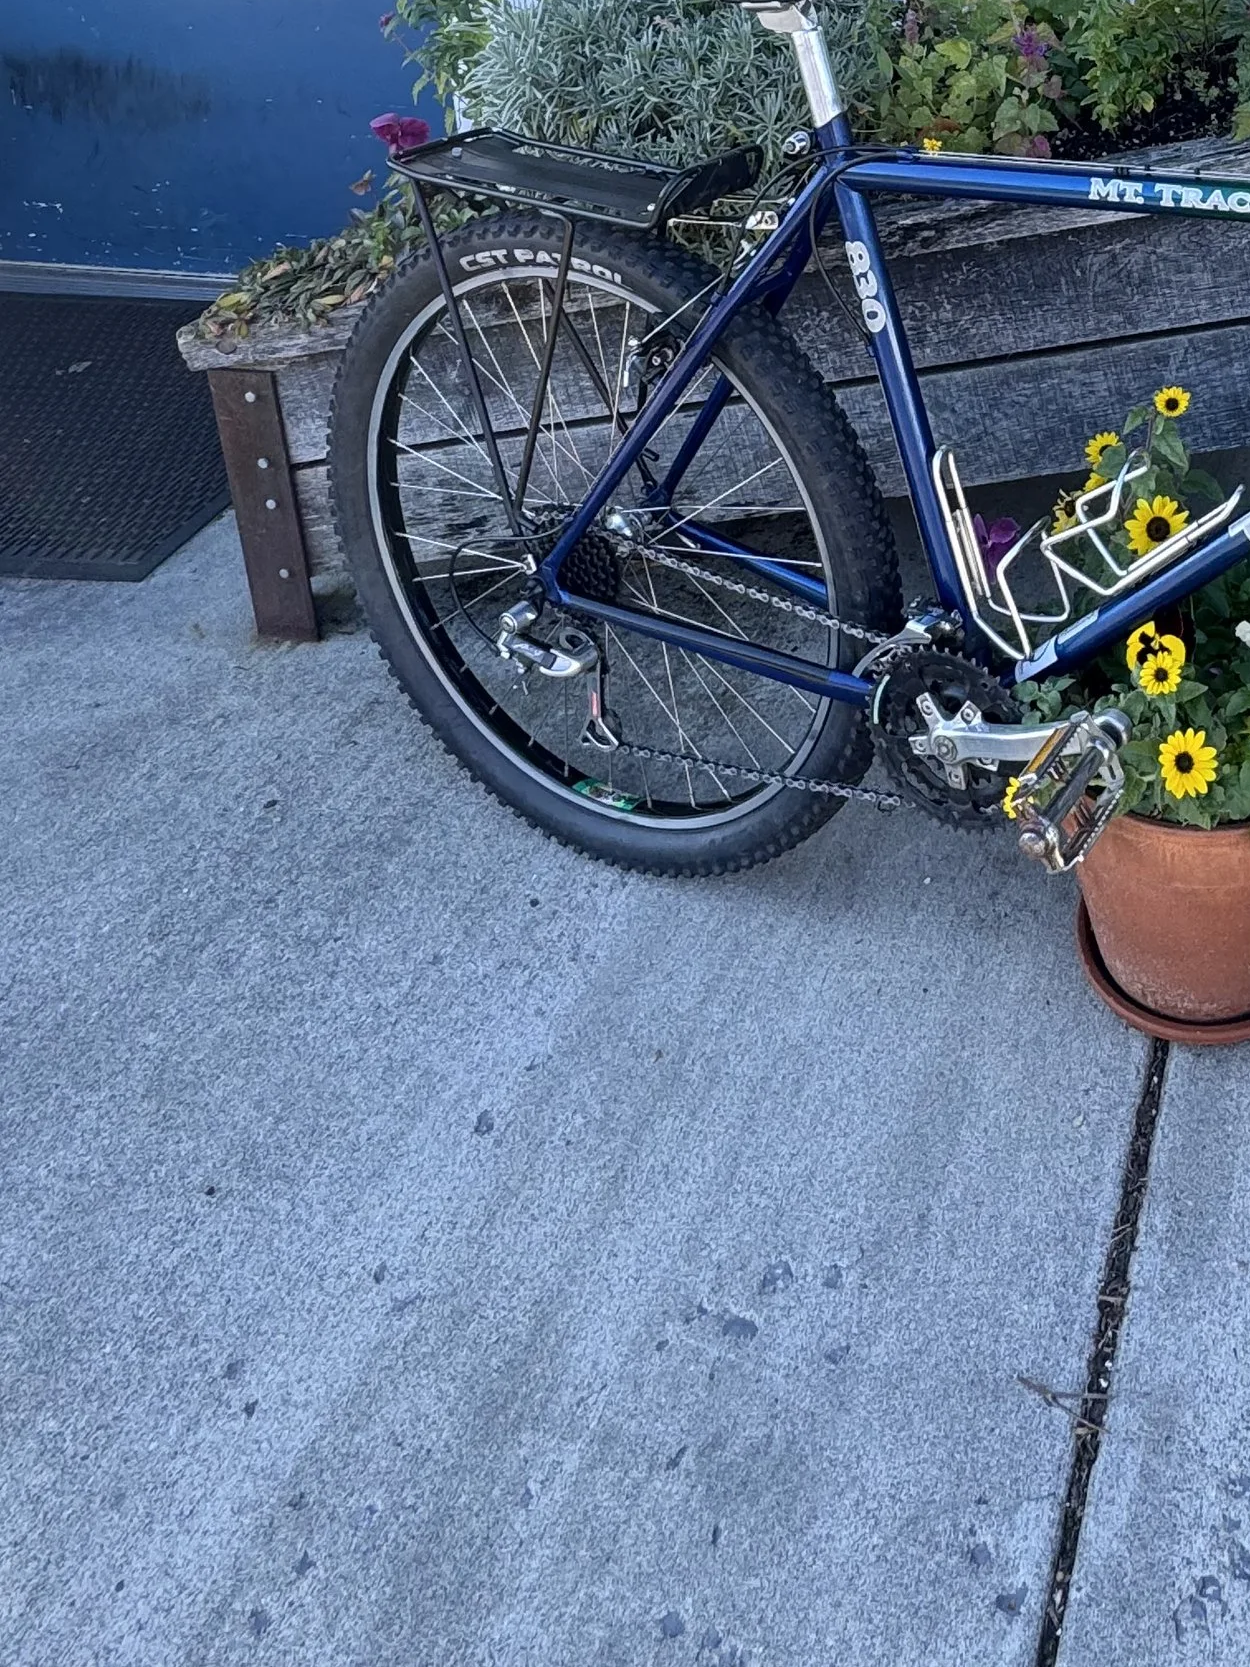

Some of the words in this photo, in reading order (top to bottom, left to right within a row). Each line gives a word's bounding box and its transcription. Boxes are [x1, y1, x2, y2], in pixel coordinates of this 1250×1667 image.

[1087, 177, 1145, 205] MT.
[459, 248, 508, 272] CST
[845, 240, 887, 333] 830
